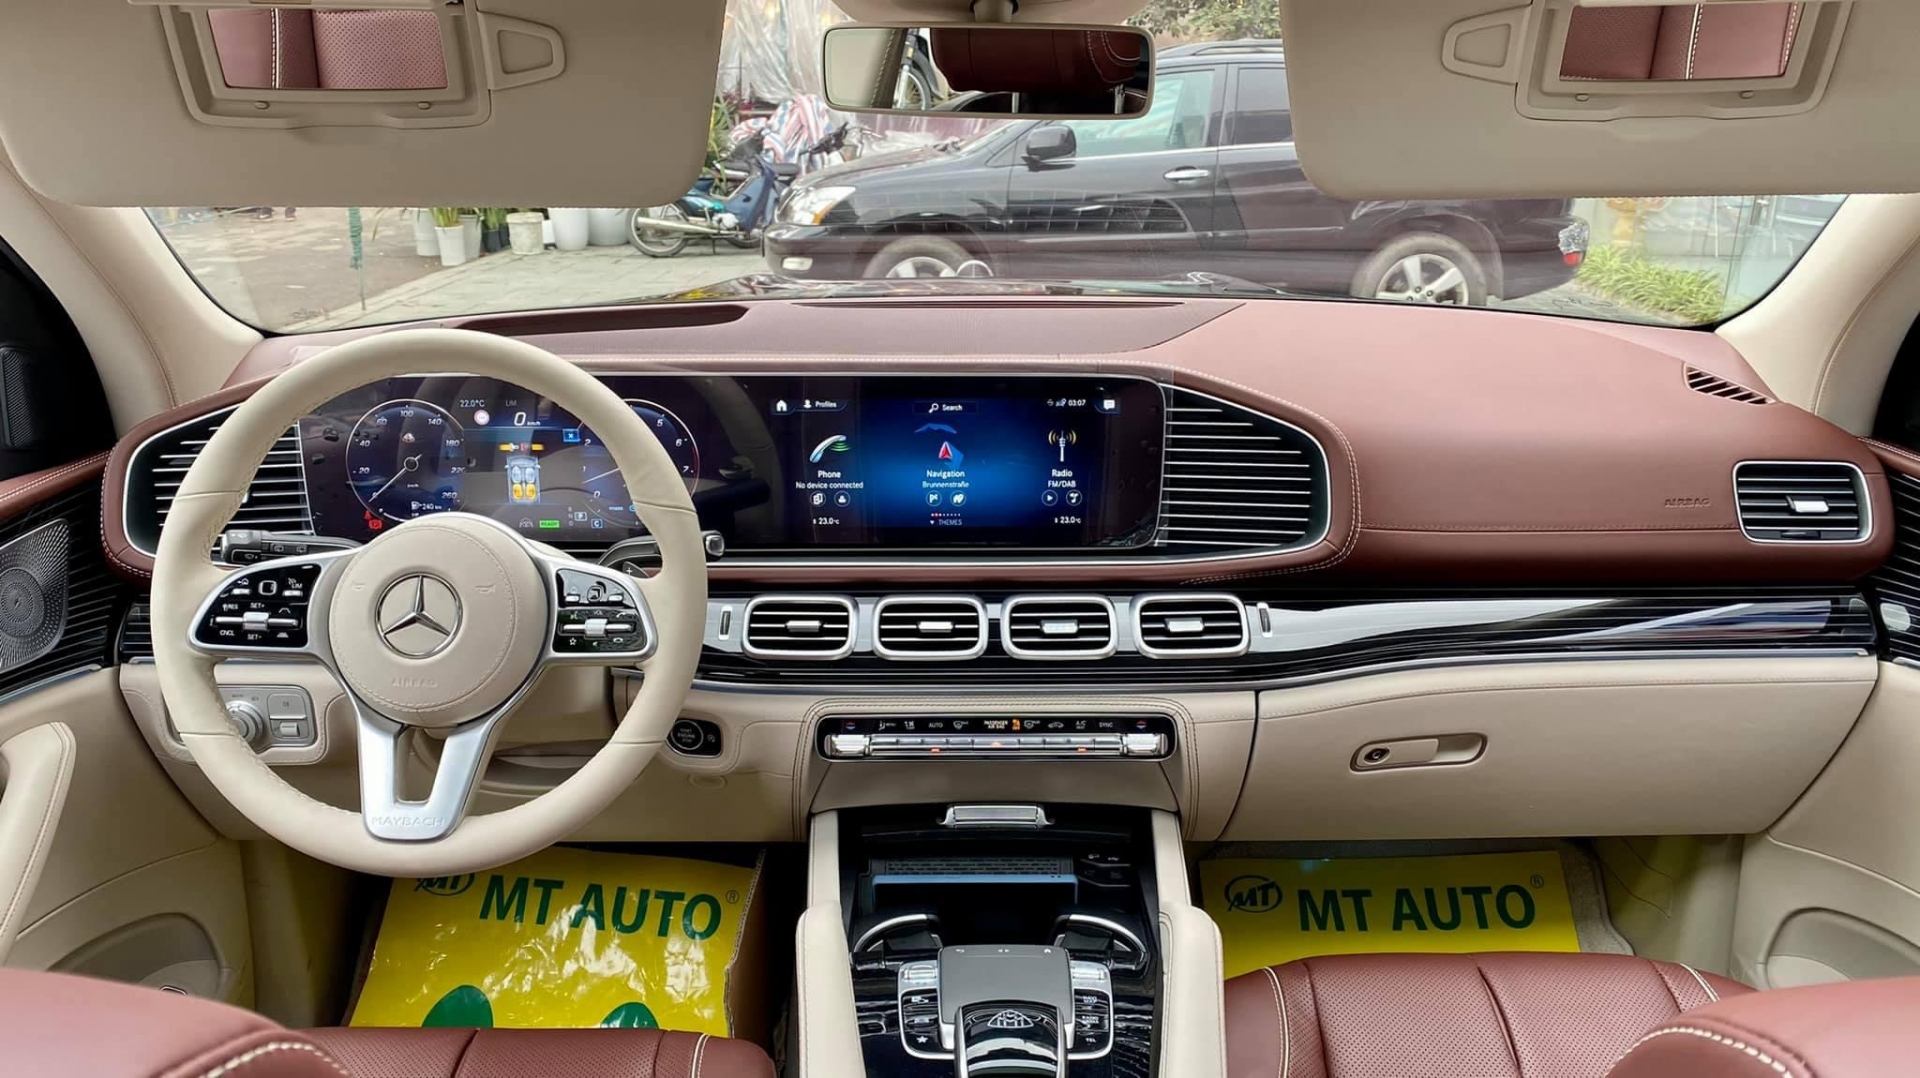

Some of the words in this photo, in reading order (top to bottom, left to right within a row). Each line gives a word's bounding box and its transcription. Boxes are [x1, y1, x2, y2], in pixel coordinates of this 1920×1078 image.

[428, 418, 442, 426] 140
[514, 412, 526, 426] 0
[656, 419, 664, 427] 5
[584, 438, 592, 446] 2
[675, 438, 682, 447] 6
[817, 470, 841, 478] Phone
[926, 470, 965, 479] Navigation
[1051, 469, 1073, 477] Radio
[594, 490, 600, 498] 0
[1664, 498, 1710, 508] AIRBAG
[390, 677, 438, 688] AIRBAG
[372, 816, 444, 826] MAYBACH
[479, 874, 564, 926] MT
[569, 884, 722, 940] AUTO
[1298, 888, 1372, 932] MT
[1392, 884, 1536, 931] AUTO
